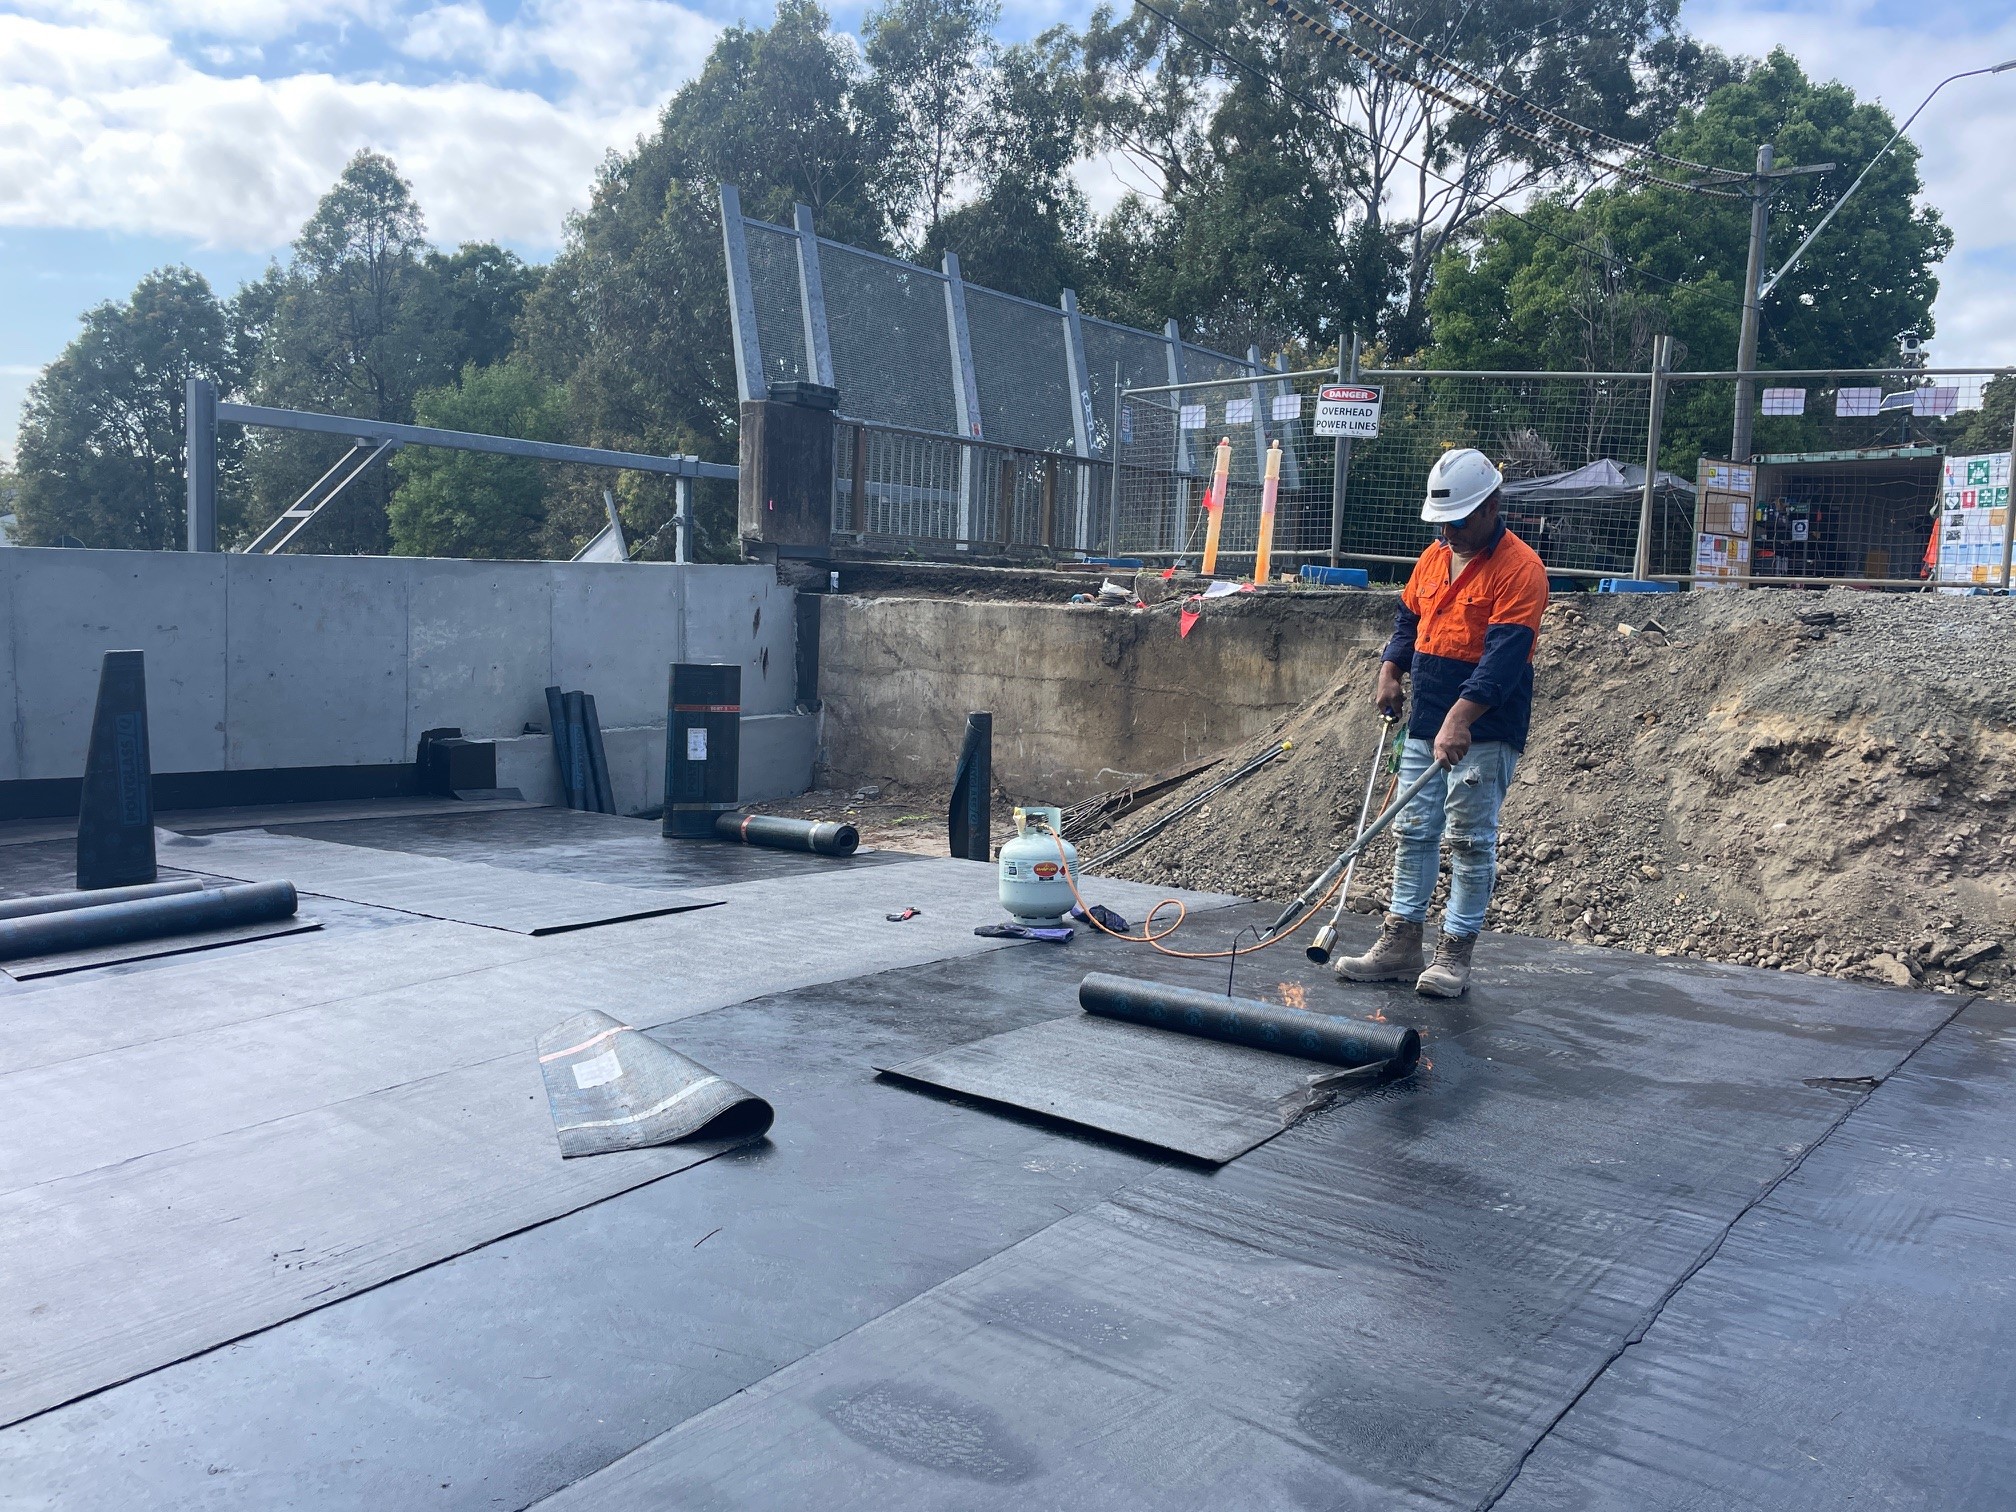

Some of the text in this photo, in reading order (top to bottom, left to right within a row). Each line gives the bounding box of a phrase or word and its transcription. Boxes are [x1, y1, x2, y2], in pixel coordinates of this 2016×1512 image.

[1329, 391, 1368, 399] DANGER
[1322, 407, 1373, 417] OVERHEAD
[1317, 420, 1377, 430] POWER LINES
